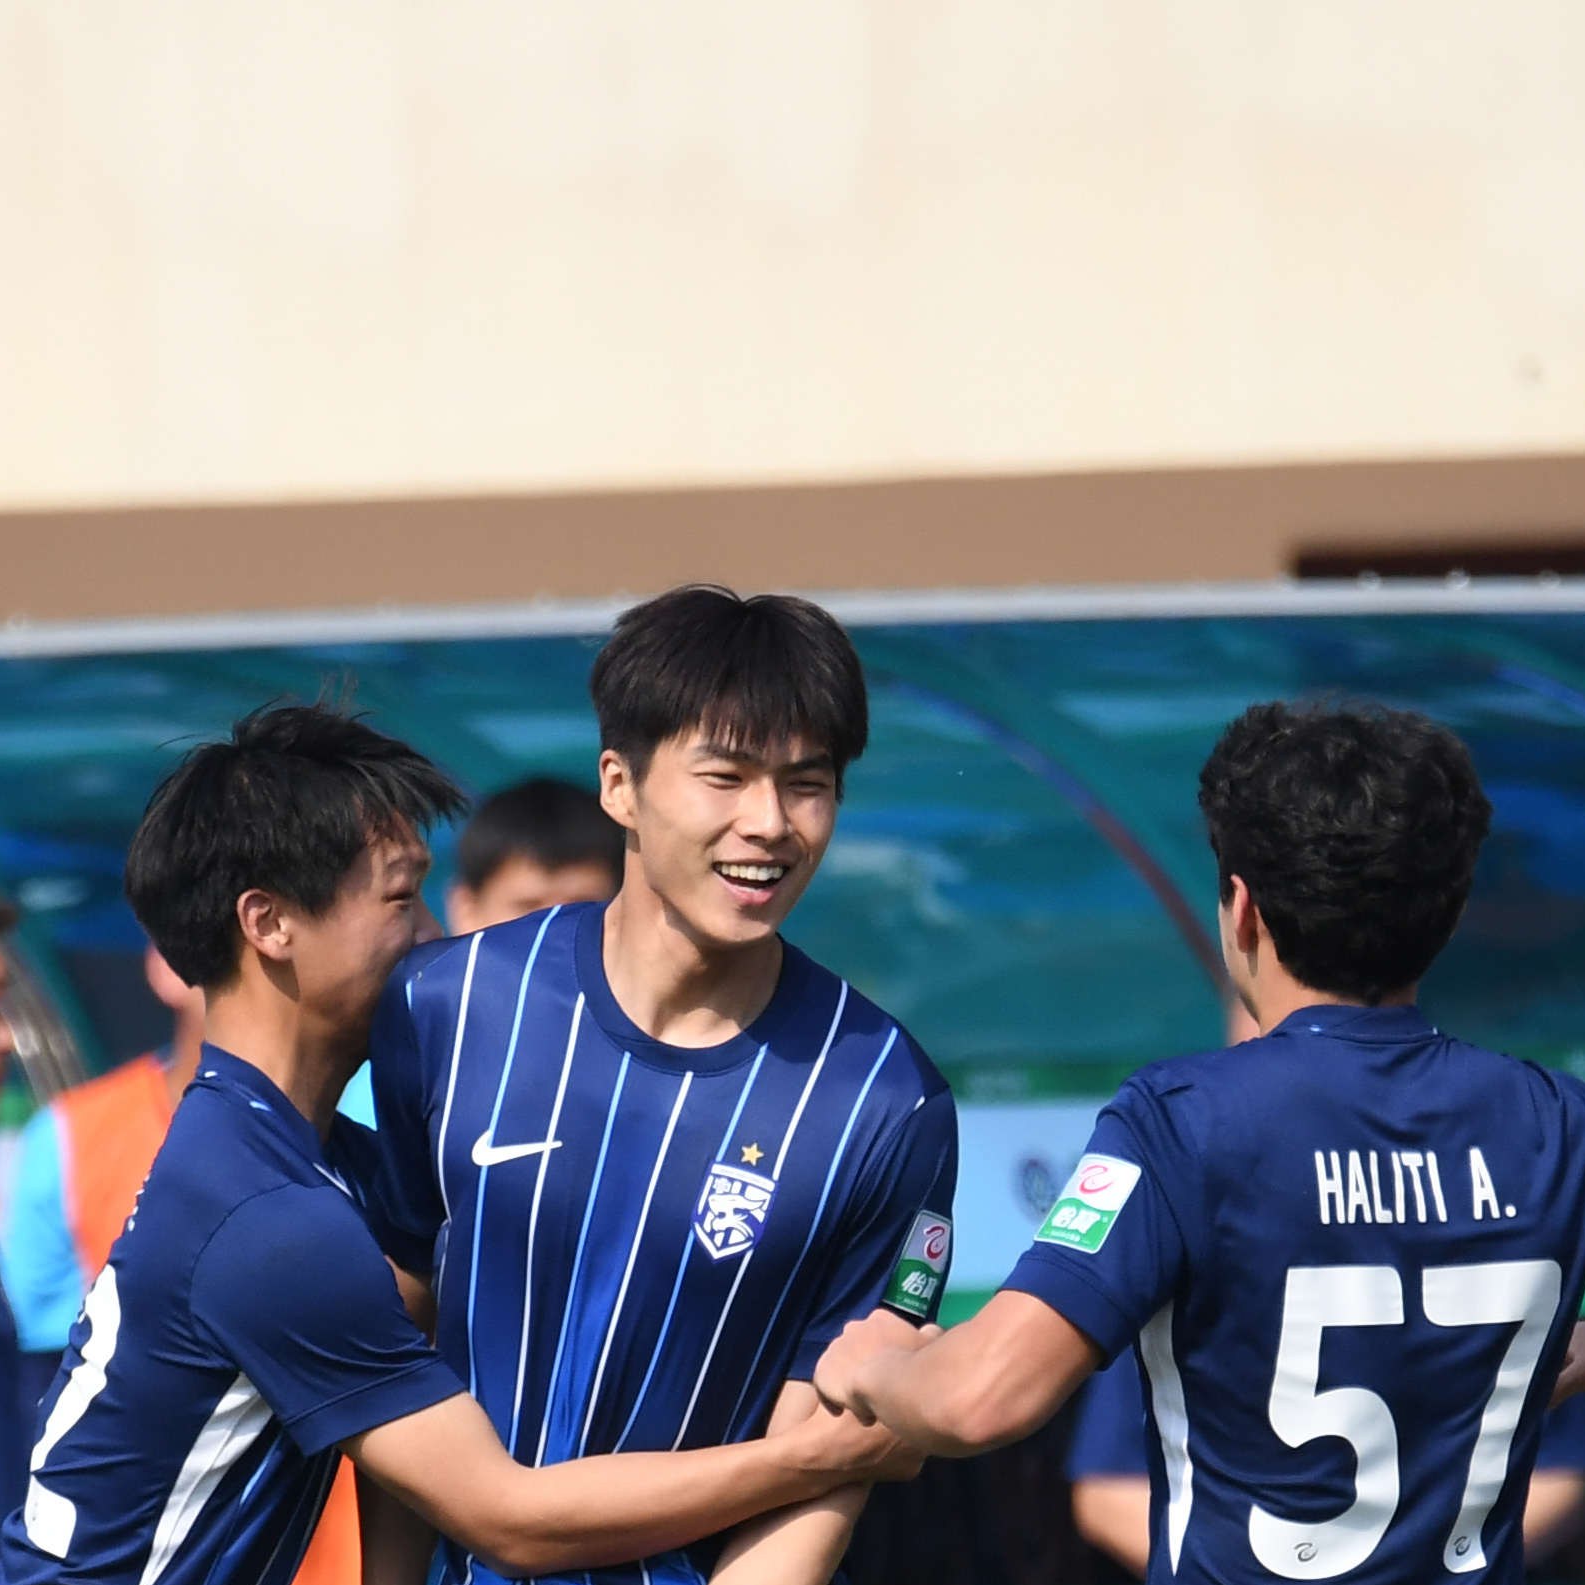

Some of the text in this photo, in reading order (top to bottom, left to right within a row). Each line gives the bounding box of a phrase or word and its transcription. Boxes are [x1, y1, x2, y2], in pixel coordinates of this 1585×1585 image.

[1313, 1146, 1518, 1226] HALITI A.
[23, 1262, 121, 1559] 2
[1248, 1259, 1563, 1580] 57
